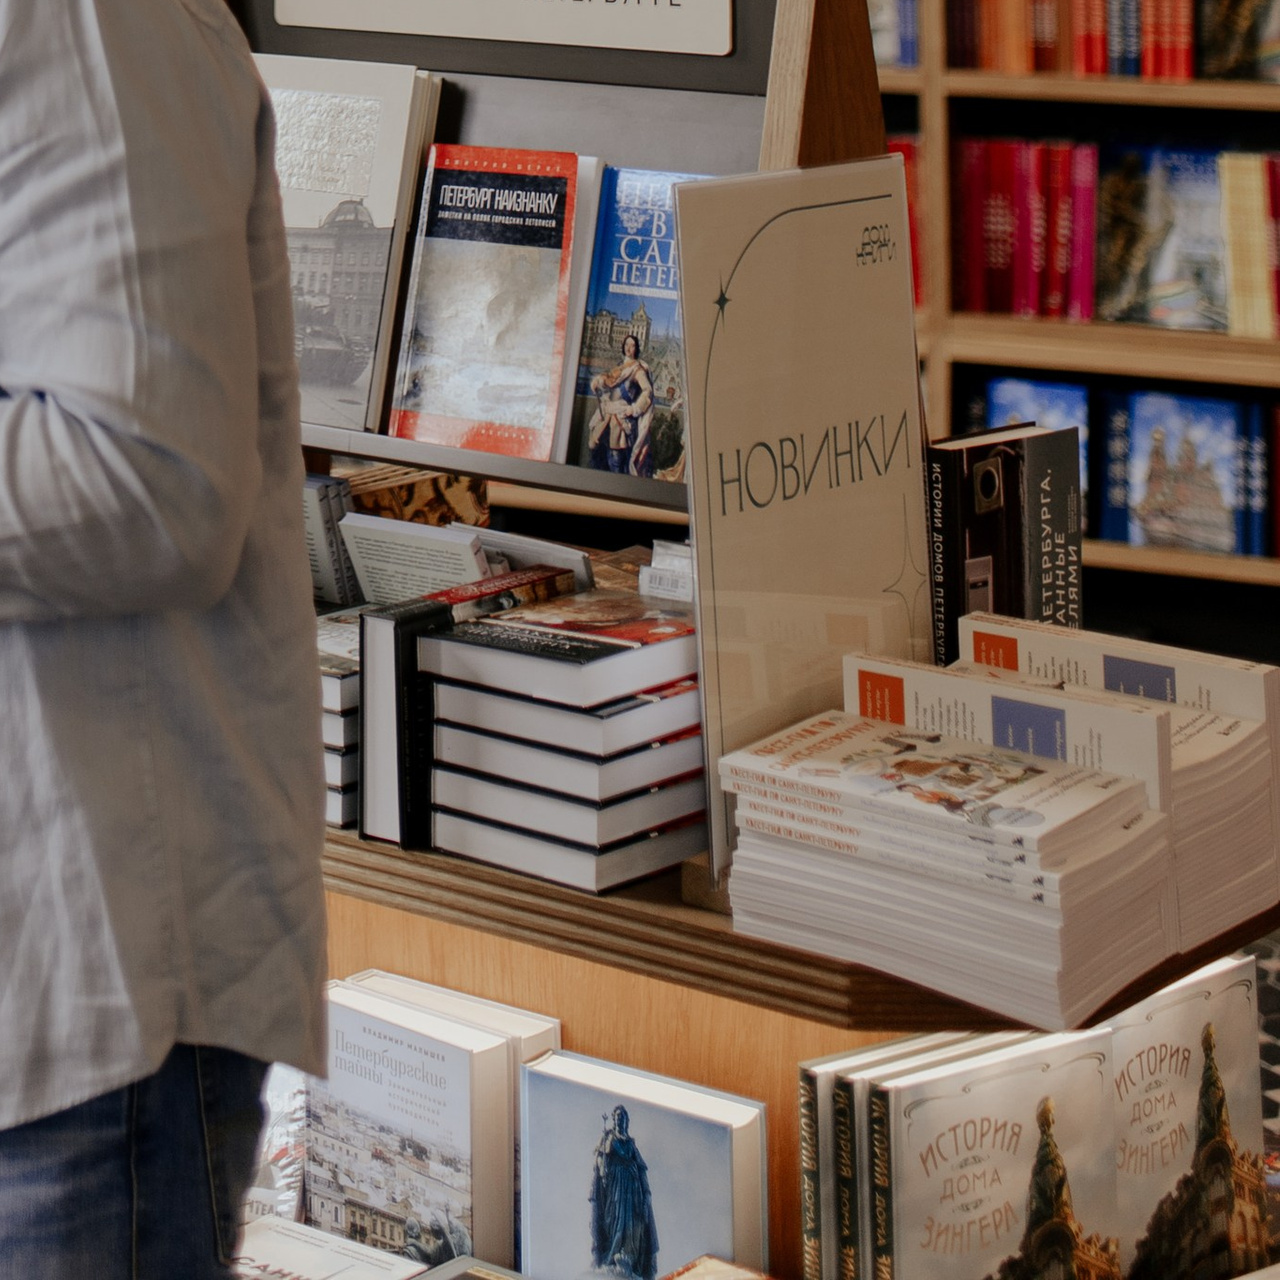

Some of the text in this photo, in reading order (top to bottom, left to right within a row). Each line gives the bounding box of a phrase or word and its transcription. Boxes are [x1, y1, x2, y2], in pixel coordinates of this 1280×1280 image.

[439, 184, 559, 215] ПЕТЕРБУРГ НАИЗНАНКУ
[651, 210, 667, 238] В
[719, 409, 911, 516] НОВИНКИ
[931, 462, 943, 528] ИСТОРИИ
[932, 531, 944, 583] ДОМОВ
[1040, 468, 1054, 625] ЕТЕРБУРГА.
[334, 1054, 383, 1086] тайны
[335, 1028, 448, 1090] Петербургские
[1115, 1043, 1191, 1102] ИСТОРИЯ
[1129, 1090, 1177, 1127] ДОМА
[919, 1116, 1023, 1178] ИСТОРИЯ
[1116, 1121, 1190, 1176] ЗИНГЕРА
[939, 1167, 1003, 1204] ДОМА
[920, 1200, 1020, 1255] ЗИНГЕРА
